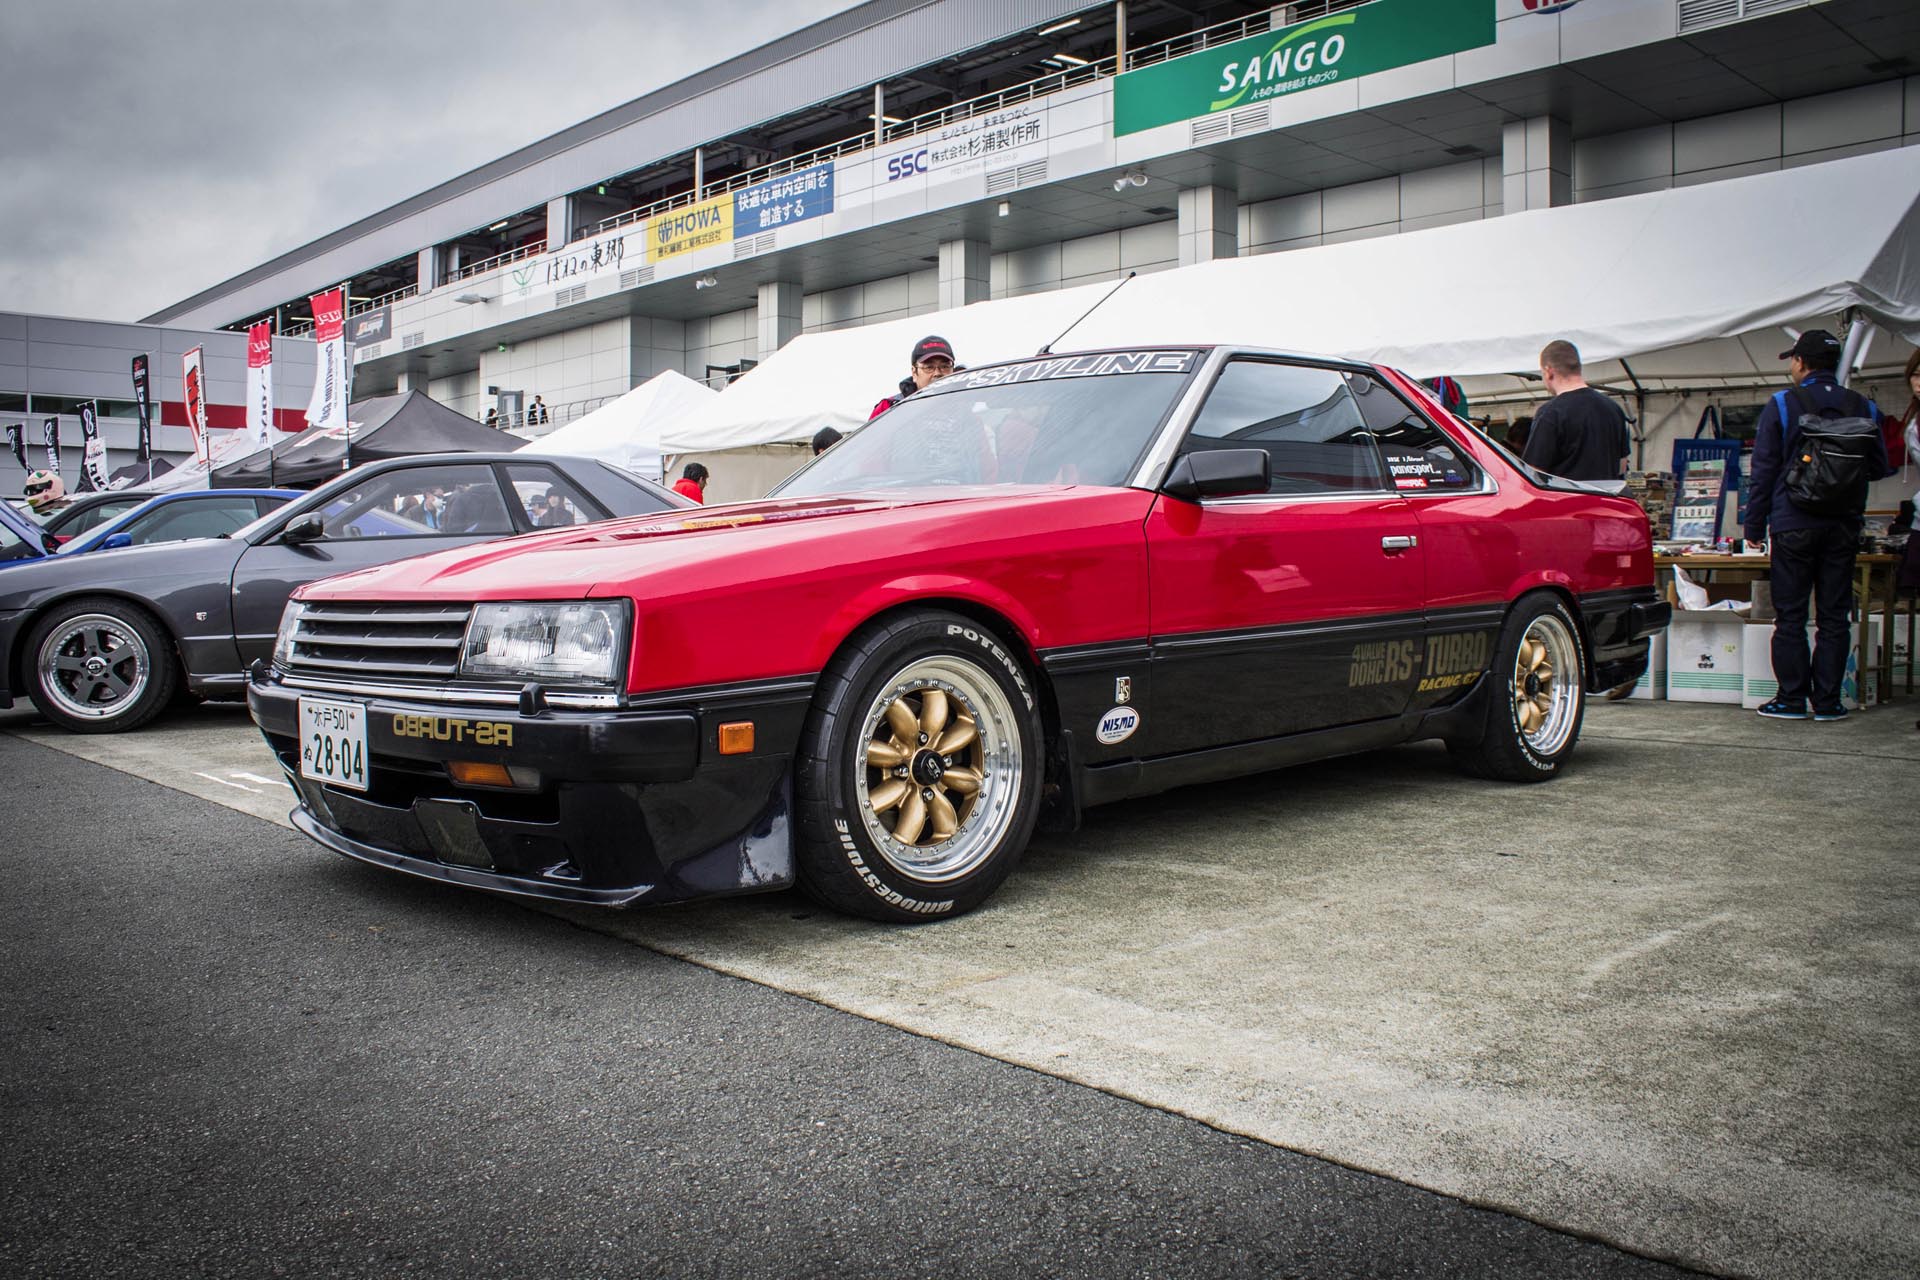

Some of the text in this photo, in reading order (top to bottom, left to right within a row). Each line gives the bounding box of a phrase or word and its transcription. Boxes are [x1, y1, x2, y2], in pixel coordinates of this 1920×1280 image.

[1218, 34, 1345, 93] SANGO
[888, 149, 928, 181] SSC
[738, 169, 829, 212] 快適な車内空間を
[674, 205, 722, 237] HOWA
[759, 199, 805, 228] 創造する
[546, 236, 625, 286] ばねの東郷
[966, 351, 1192, 388] SKYLINE
[947, 624, 1033, 711] POTENZA
[1349, 660, 1384, 688] DOHC
[1418, 674, 1461, 692] RACING
[1102, 716, 1135, 732] NISMO
[313, 733, 364, 783] 28-04
